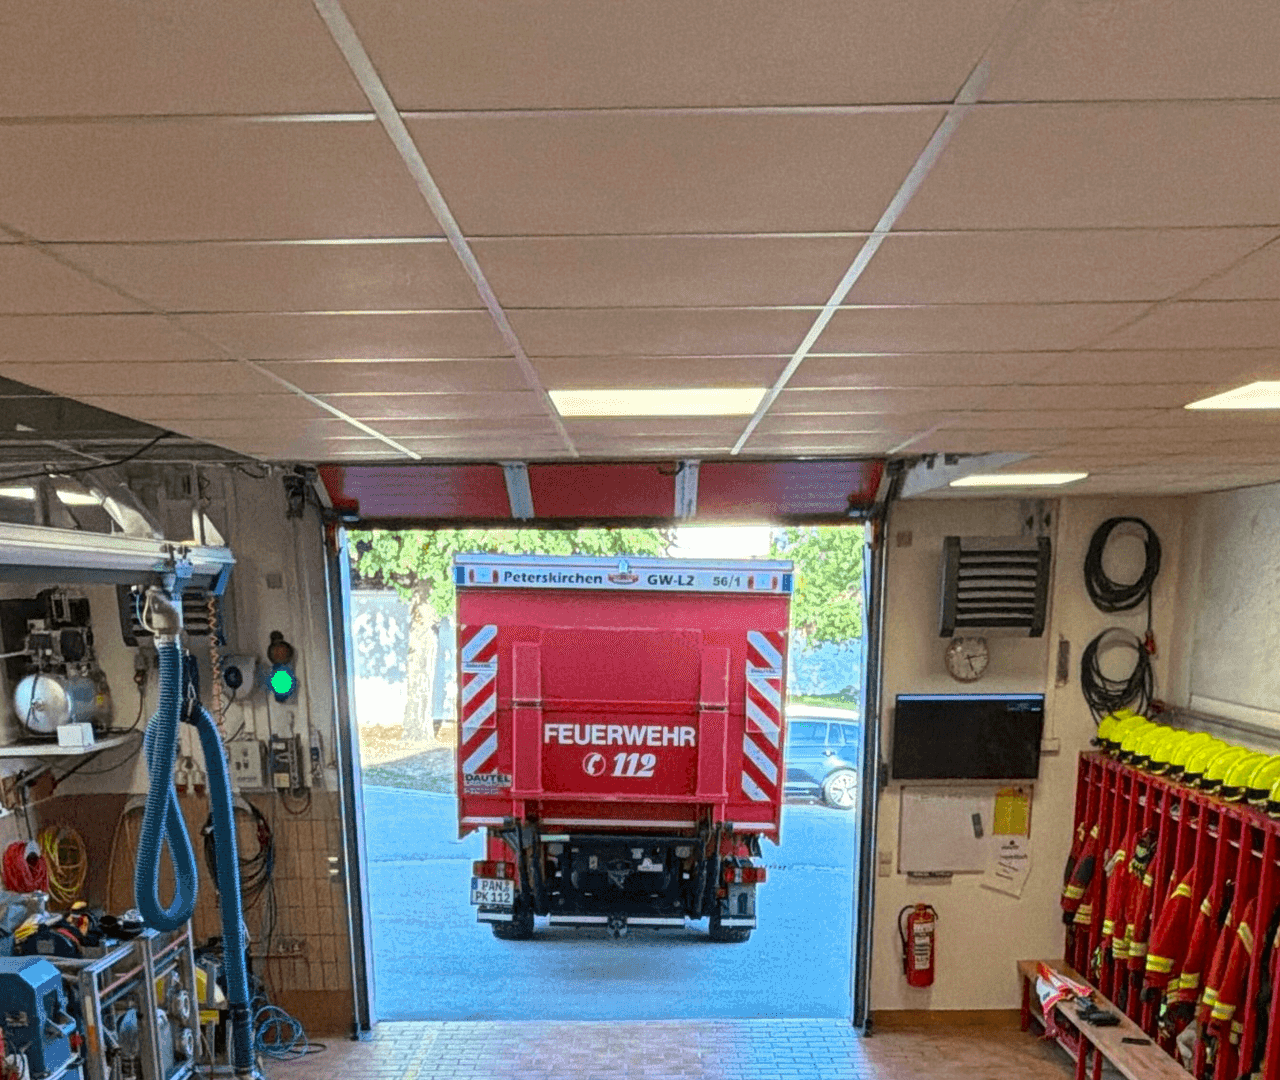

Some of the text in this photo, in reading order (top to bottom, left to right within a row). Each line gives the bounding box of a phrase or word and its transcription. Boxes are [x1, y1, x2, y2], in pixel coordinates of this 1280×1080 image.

[504, 570, 741, 588] Peterskirchen GW-L2 56/1
[544, 723, 696, 747] FEUERWEHR
[611, 752, 656, 778] 112
[465, 773, 511, 783] DAUTEL
[481, 880, 503, 891] PAN
